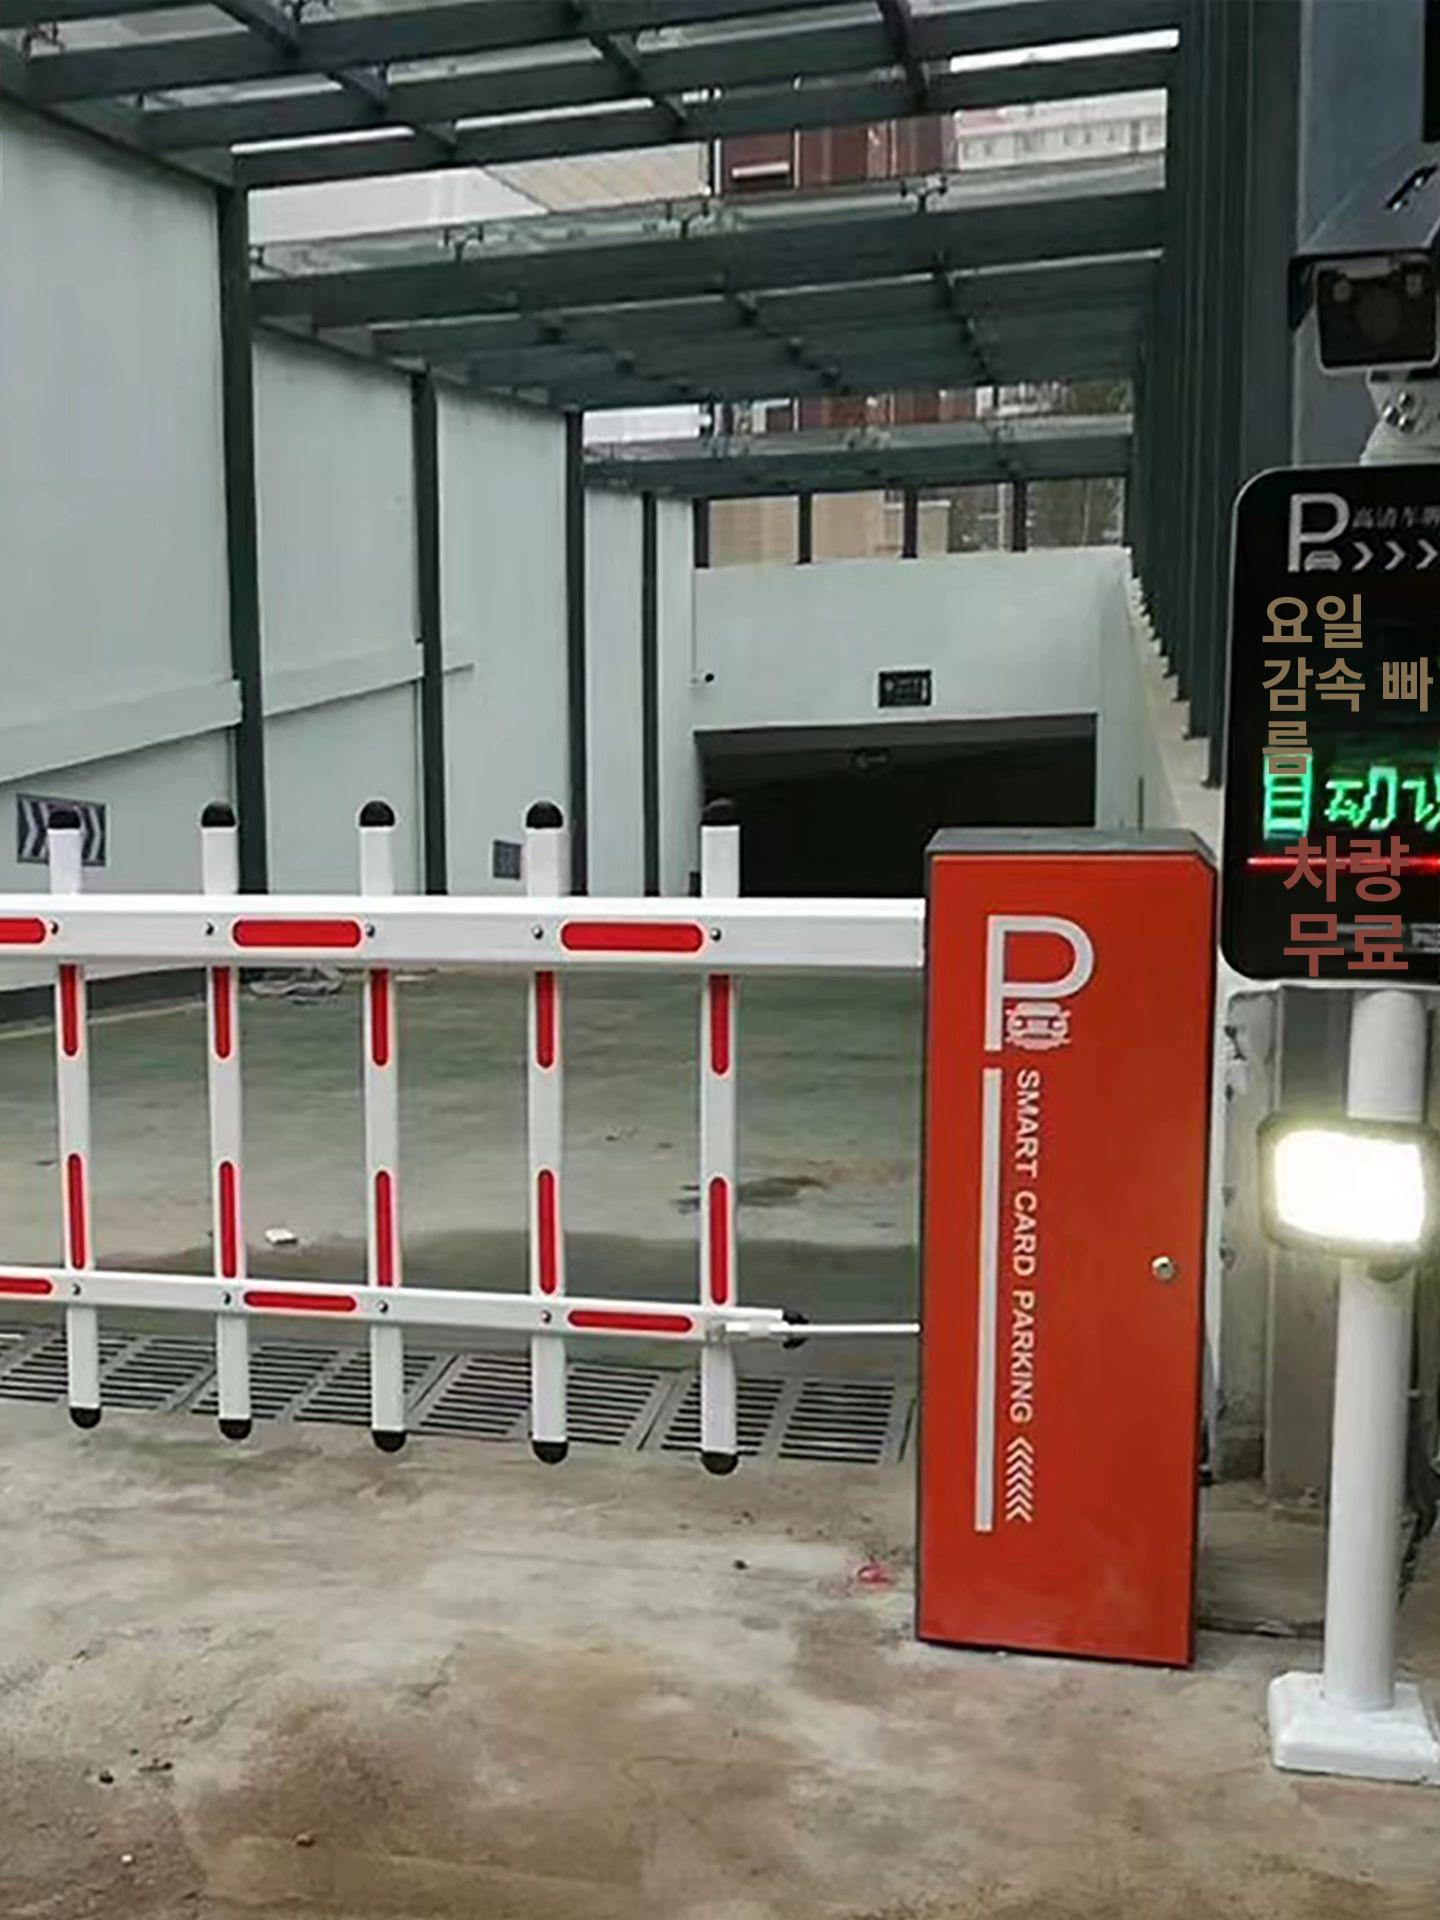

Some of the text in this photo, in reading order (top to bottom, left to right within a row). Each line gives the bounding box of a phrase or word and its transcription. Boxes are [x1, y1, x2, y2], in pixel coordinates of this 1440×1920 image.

[1288, 493, 1350, 572] P
[985, 915, 1094, 1051] P
[1010, 1069, 1041, 1424] SMART CARD PARKING
